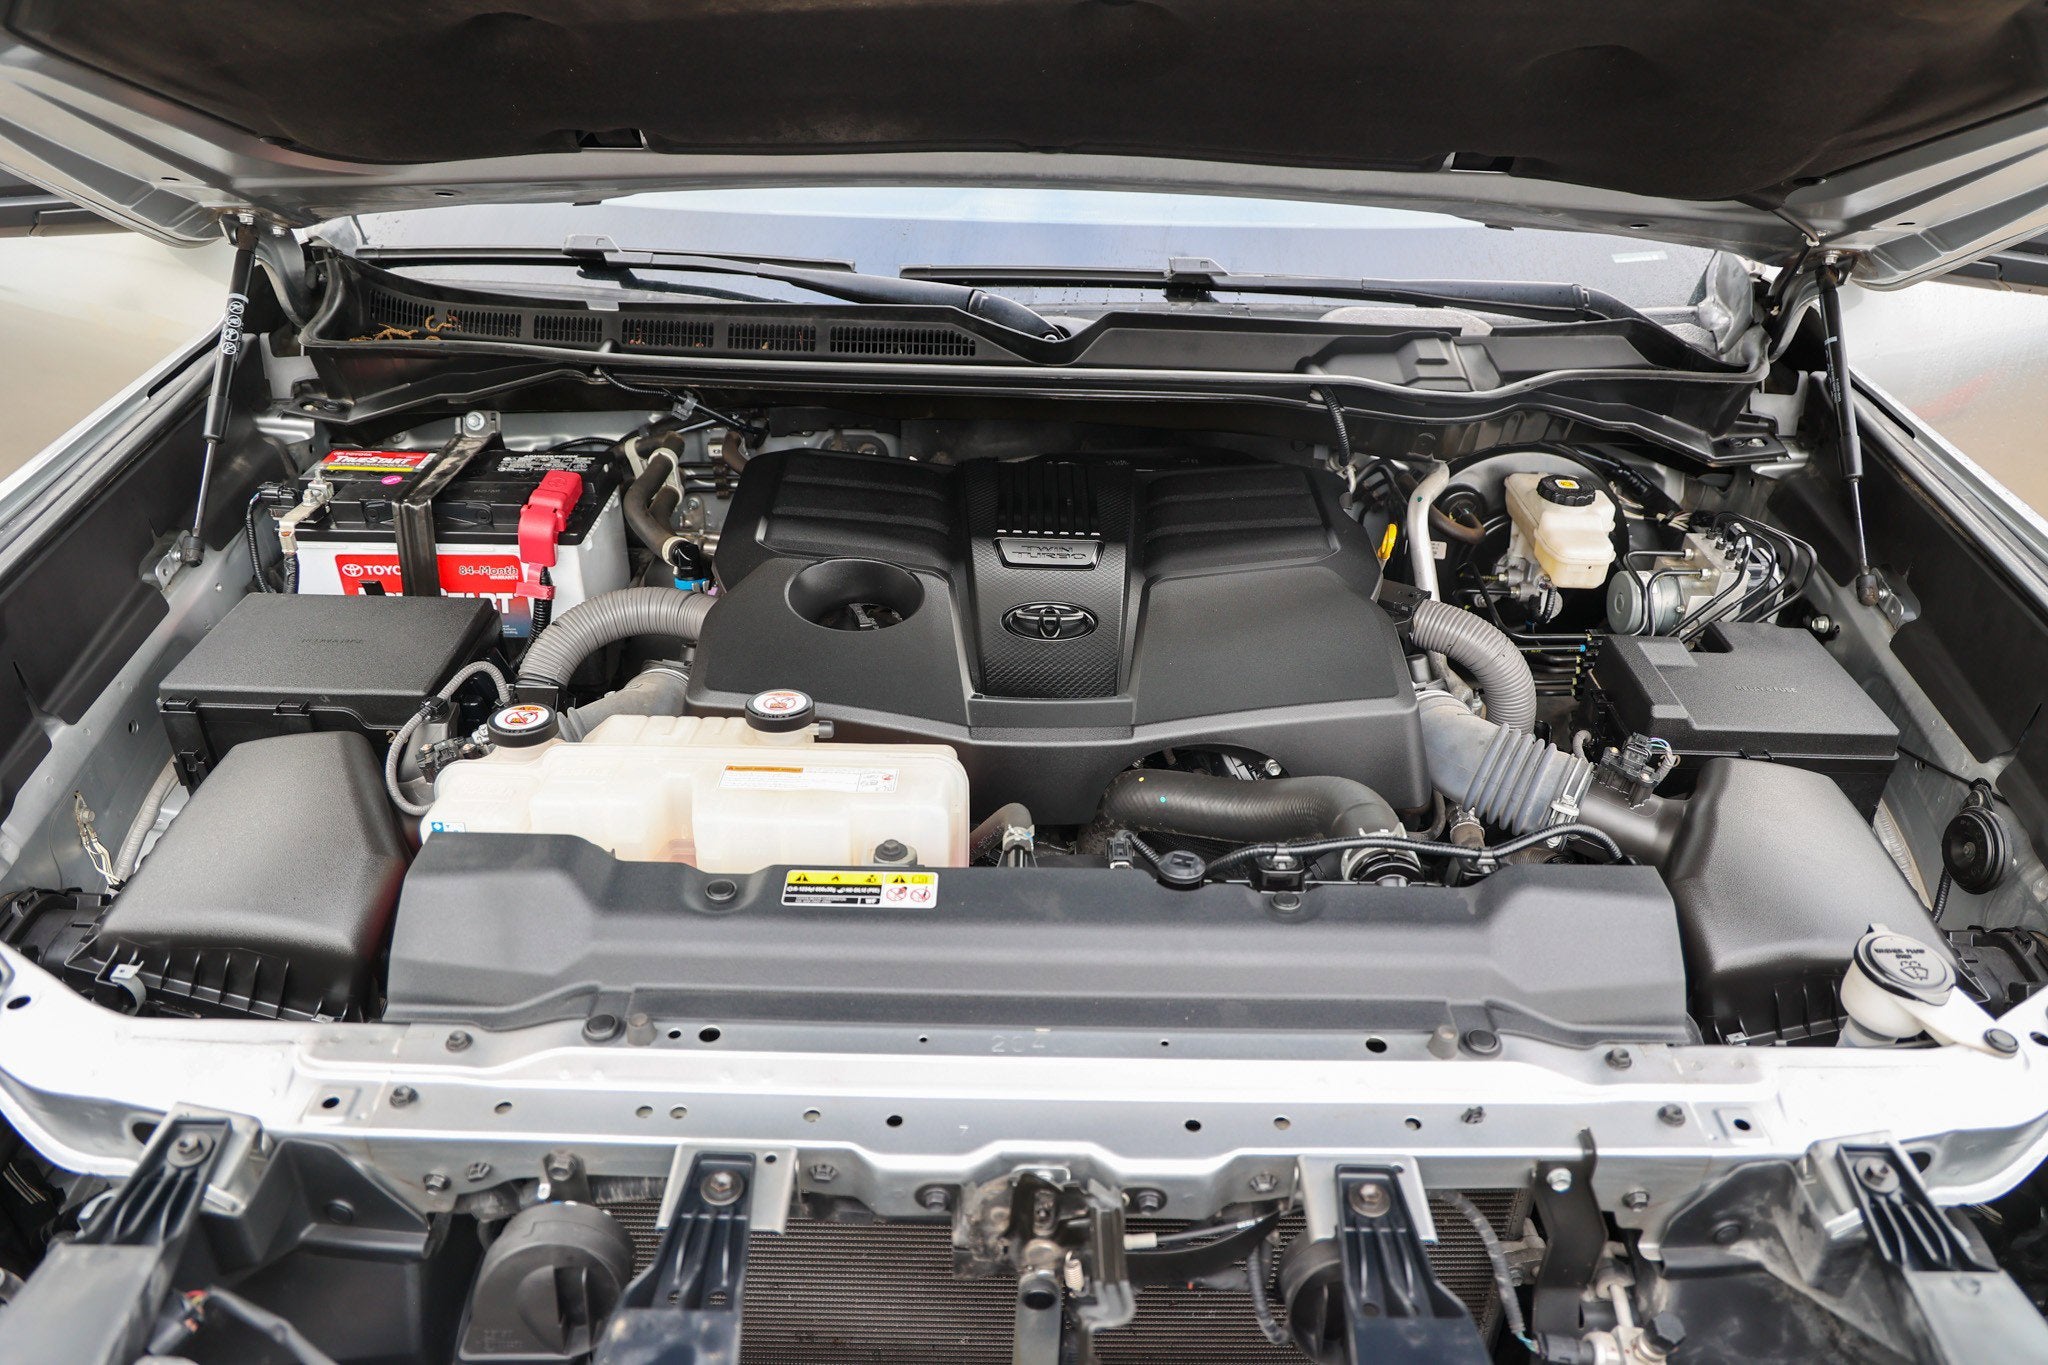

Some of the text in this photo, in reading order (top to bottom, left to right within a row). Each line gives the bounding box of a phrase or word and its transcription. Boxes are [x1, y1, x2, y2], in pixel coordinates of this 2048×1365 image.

[1021, 545, 1073, 553] TWIN
[1012, 551, 1087, 560] TURBO
[363, 565, 401, 576] TOYO
[459, 565, 518, 576] 84-Month
